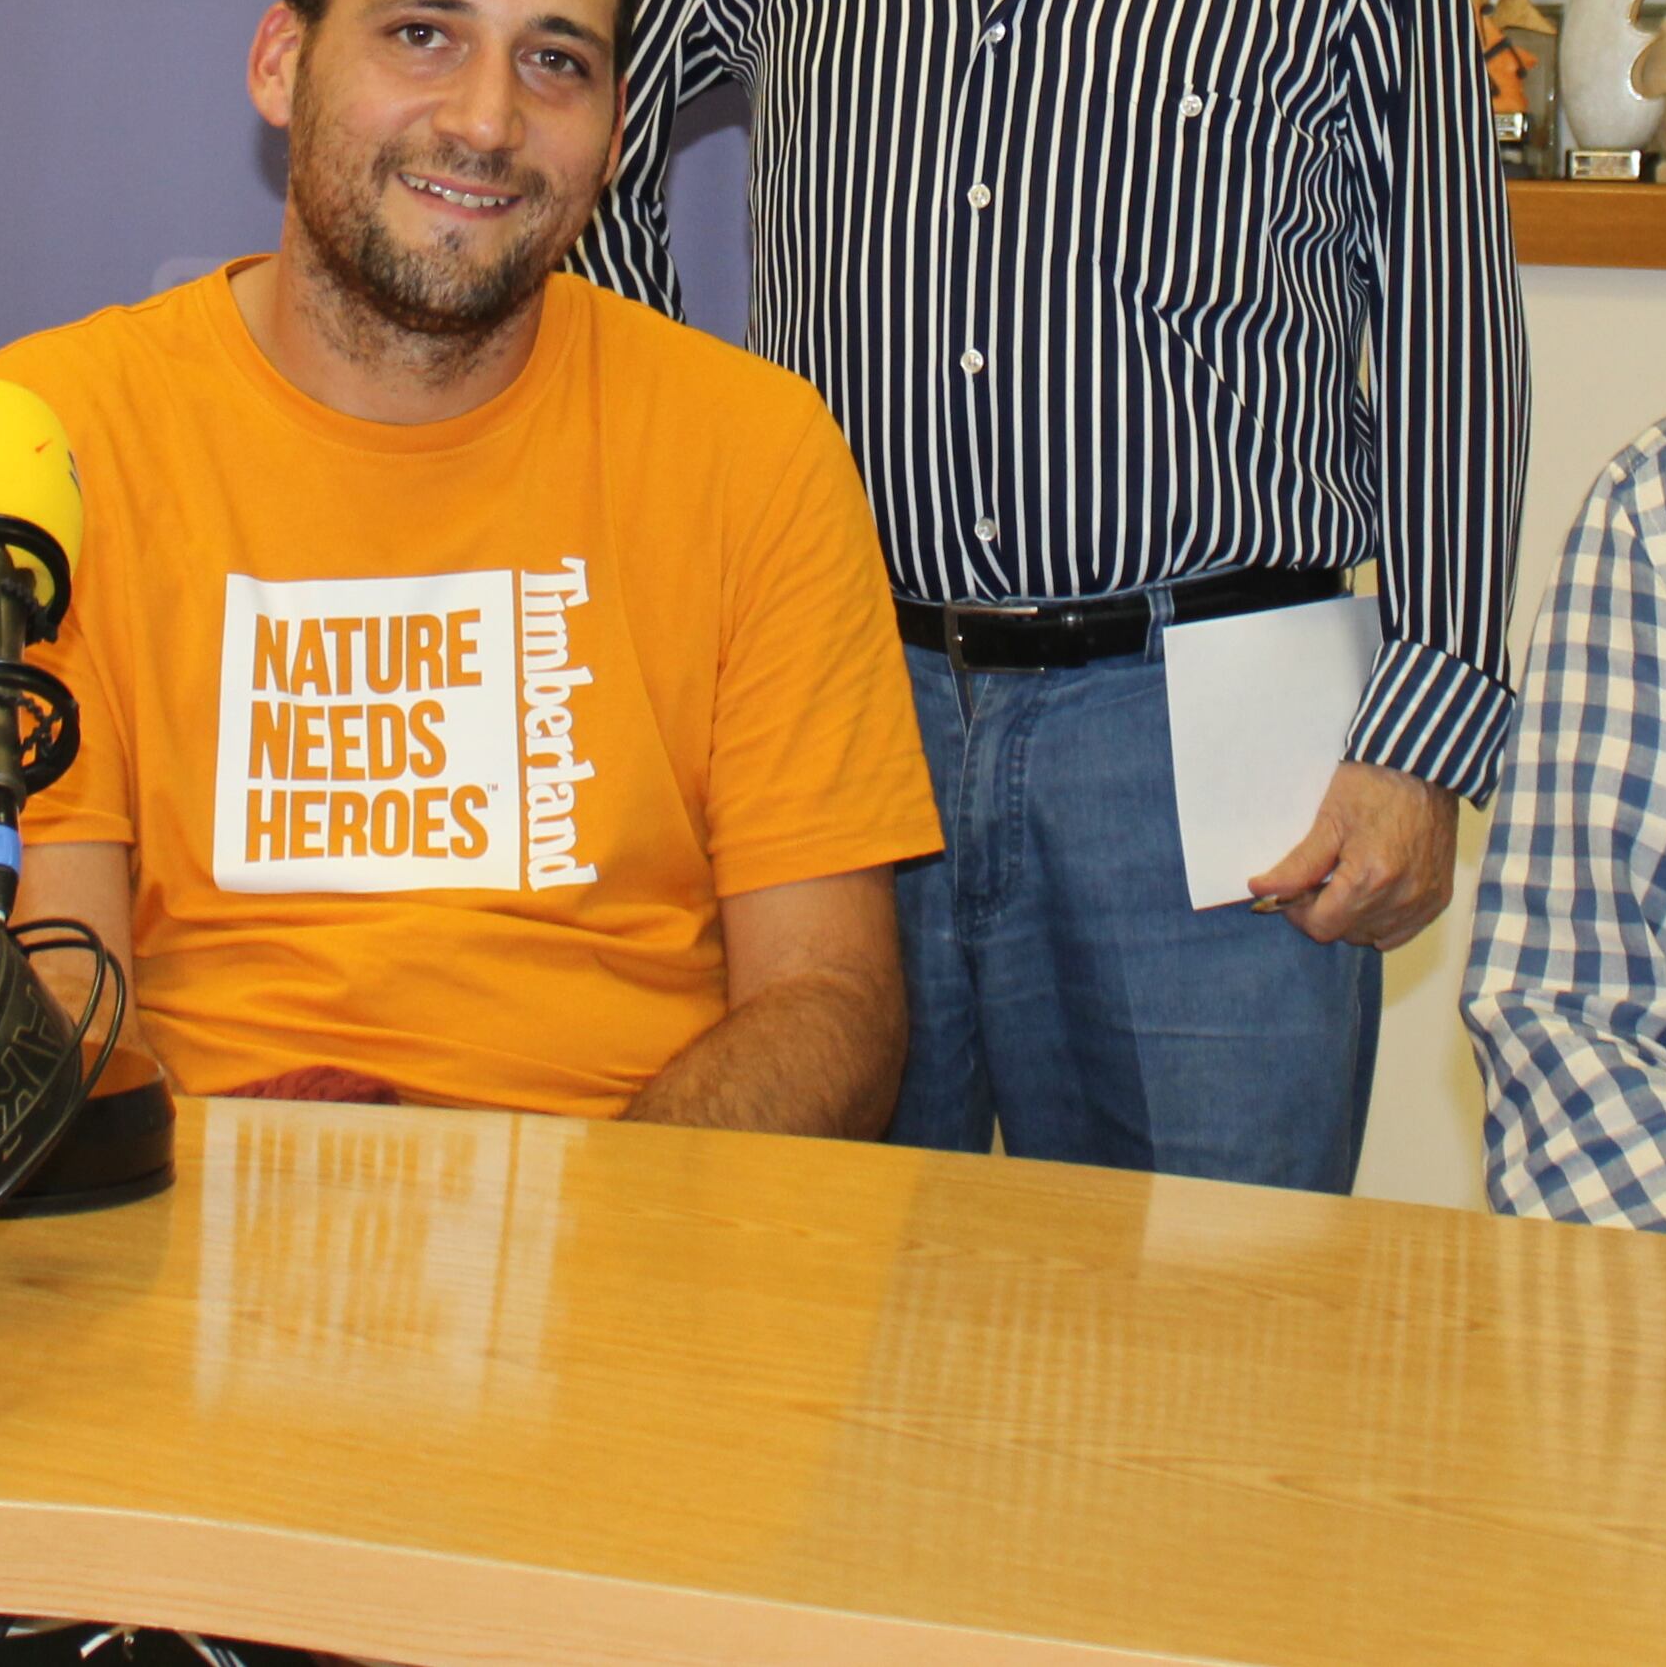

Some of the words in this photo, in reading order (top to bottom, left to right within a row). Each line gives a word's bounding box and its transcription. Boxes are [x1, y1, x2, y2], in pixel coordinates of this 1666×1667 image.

[252, 608, 483, 697] NATURE
[248, 699, 447, 782] NEEDS
[520, 556, 599, 892] Timberland
[245, 783, 489, 864] HEROES
